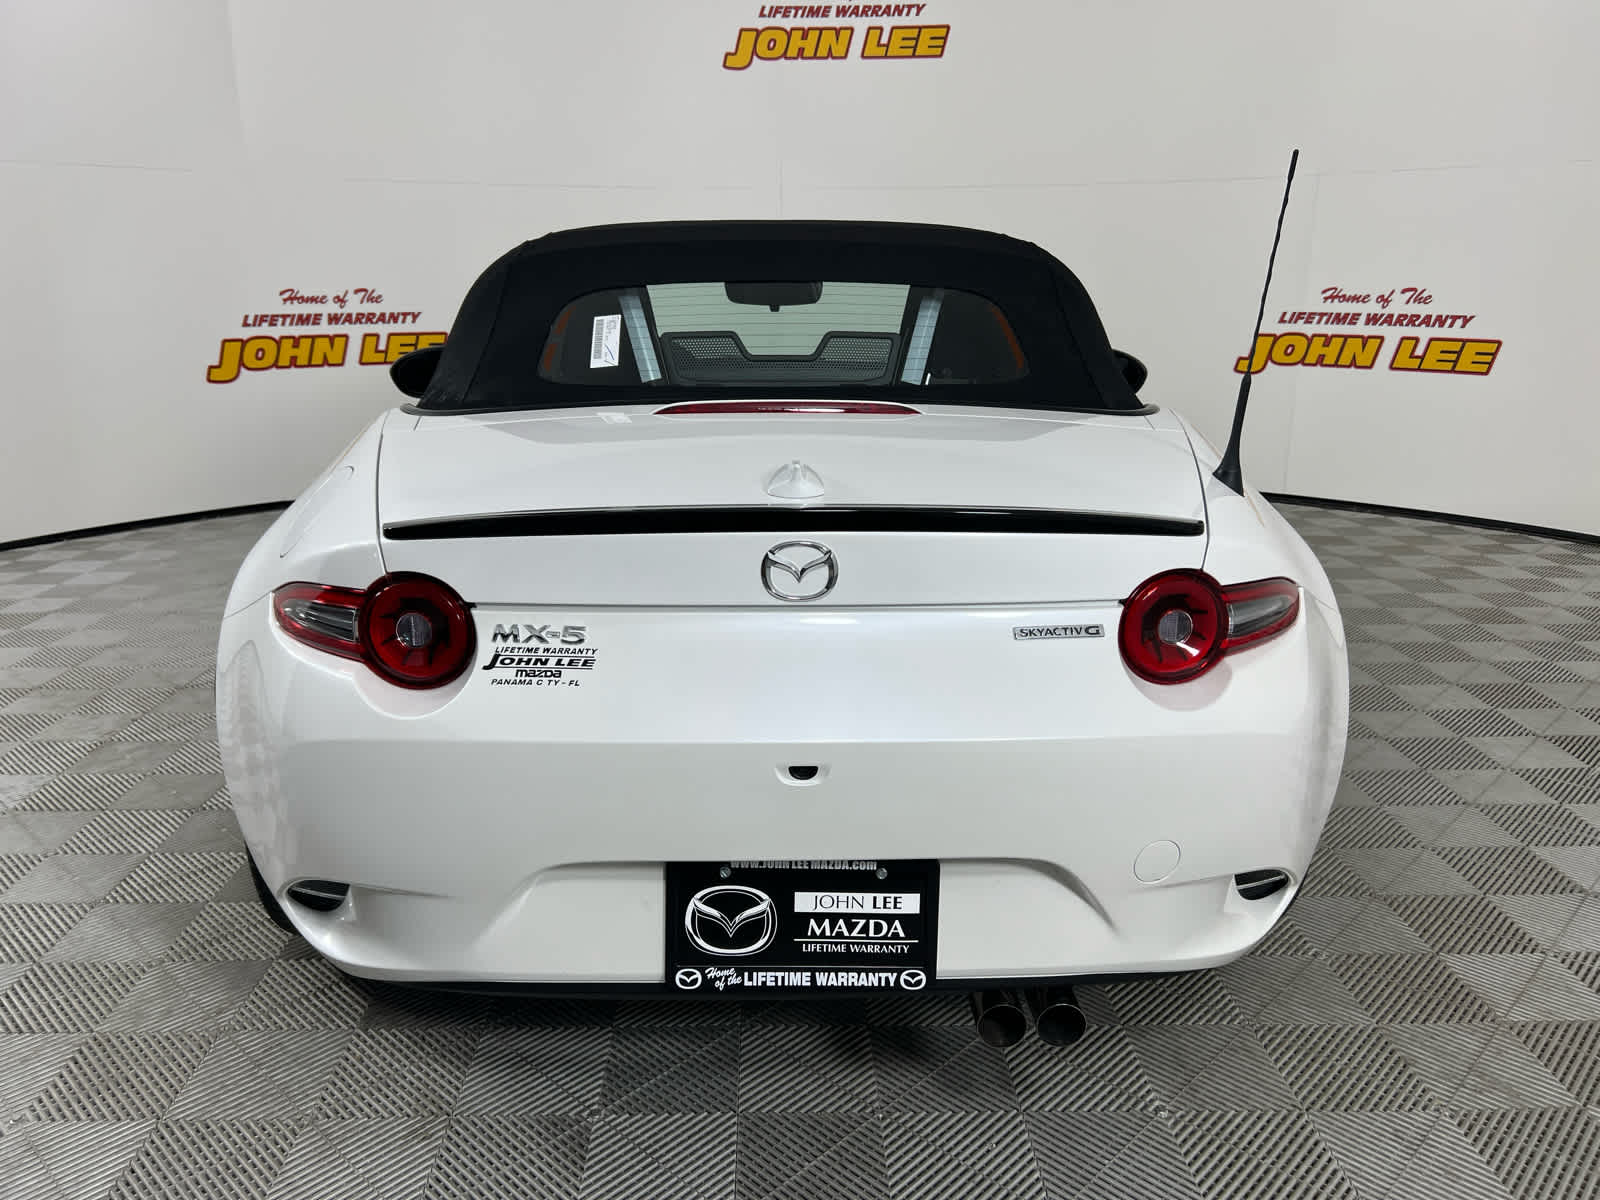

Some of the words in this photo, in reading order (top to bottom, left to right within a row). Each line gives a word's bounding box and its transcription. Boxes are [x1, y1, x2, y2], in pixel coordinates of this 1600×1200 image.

[758, 5, 833, 18] LIFETIME
[835, 3, 926, 18] WARRANTY
[722, 26, 854, 70] JOHN
[860, 24, 950, 59] LEE
[279, 288, 328, 305] Home
[333, 290, 348, 309] of
[353, 288, 384, 305] The
[1321, 286, 1371, 304] Home
[1375, 289, 1395, 309] of
[1400, 287, 1433, 305] The
[241, 313, 322, 328] LIFETIME
[327, 311, 422, 326] WARRANTY
[1278, 311, 1361, 326] LIFETIME
[1364, 312, 1476, 329] WARRANTY
[206, 334, 349, 384] JOHN
[1233, 331, 1384, 375] JOHN
[1388, 336, 1503, 376] LEE
[491, 623, 587, 645] MX-5
[1020, 626, 1082, 638] SKYACTIV
[495, 646, 540, 654] LIFETIME
[542, 647, 598, 655] WARRANTY
[482, 653, 550, 670] JOHN
[554, 657, 596, 668] LEE
[813, 894, 866, 911] JOHN
[871, 895, 903, 911] LEE
[807, 918, 906, 938] MAZDA
[802, 943, 847, 953] LIFETIME
[849, 944, 910, 954] WARRANTY
[704, 967, 736, 980] Home
[714, 979, 726, 991] of
[728, 973, 743, 986] the
[743, 970, 812, 987] LIFETIME
[814, 971, 897, 988] WARRANTY
